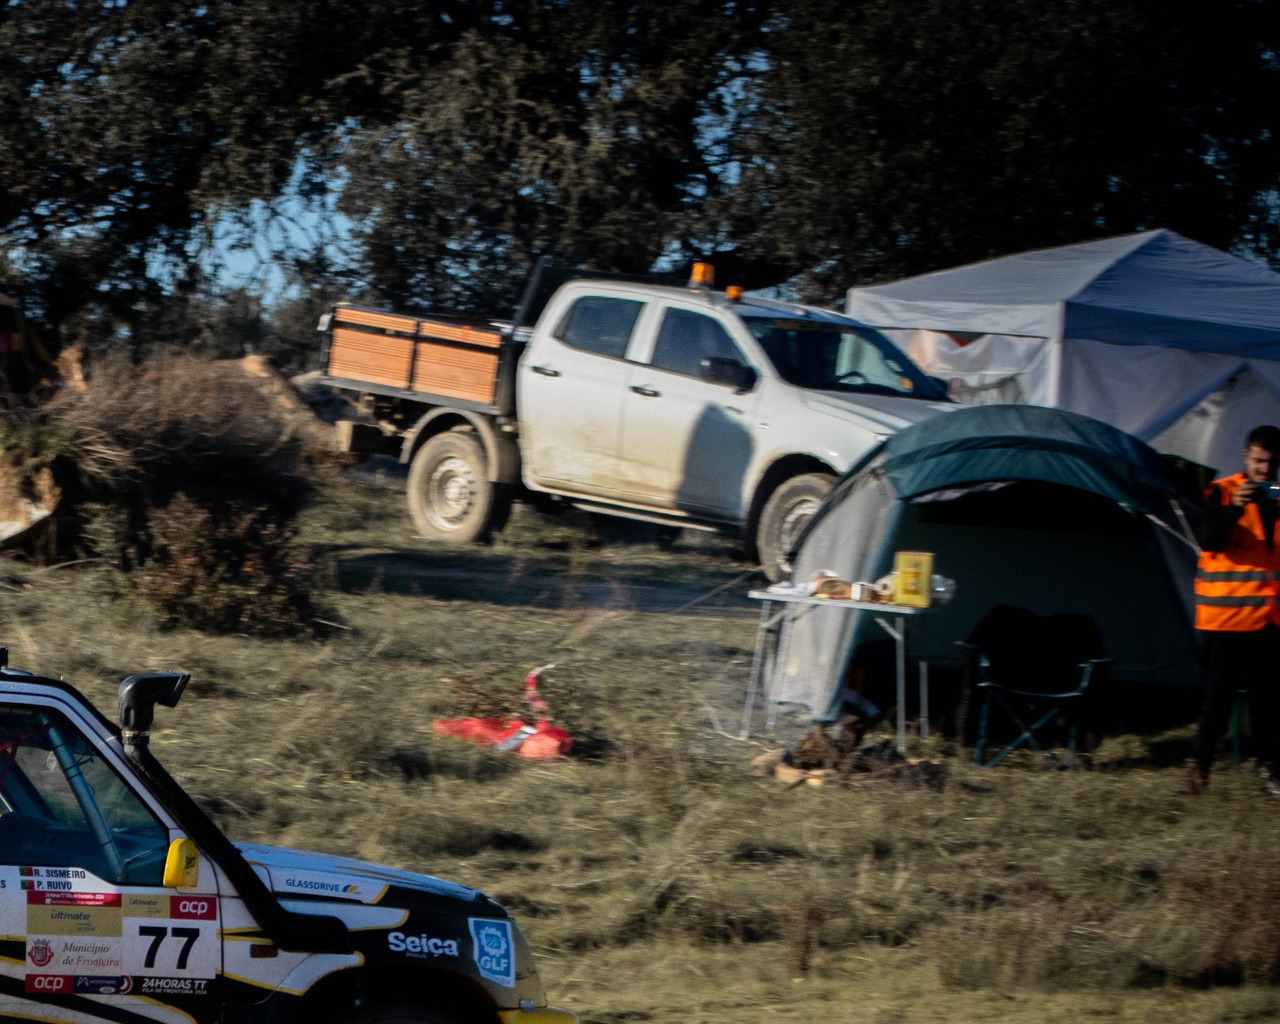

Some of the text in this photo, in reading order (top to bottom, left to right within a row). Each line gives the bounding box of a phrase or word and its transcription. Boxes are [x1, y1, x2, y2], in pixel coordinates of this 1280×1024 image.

[34, 868, 86, 879] R. SISMEIRO
[36, 881, 72, 890] P. RUIVO
[285, 878, 340, 893] GLASSDRIVE
[179, 901, 209, 915] acp
[62, 942, 110, 955] Município
[138, 925, 200, 970] 77
[387, 931, 459, 957] Seiça
[63, 955, 120, 967] de Fronteira
[480, 956, 509, 972] GLF
[34, 976, 64, 991] acp
[142, 978, 207, 990] 24HORAS TT
